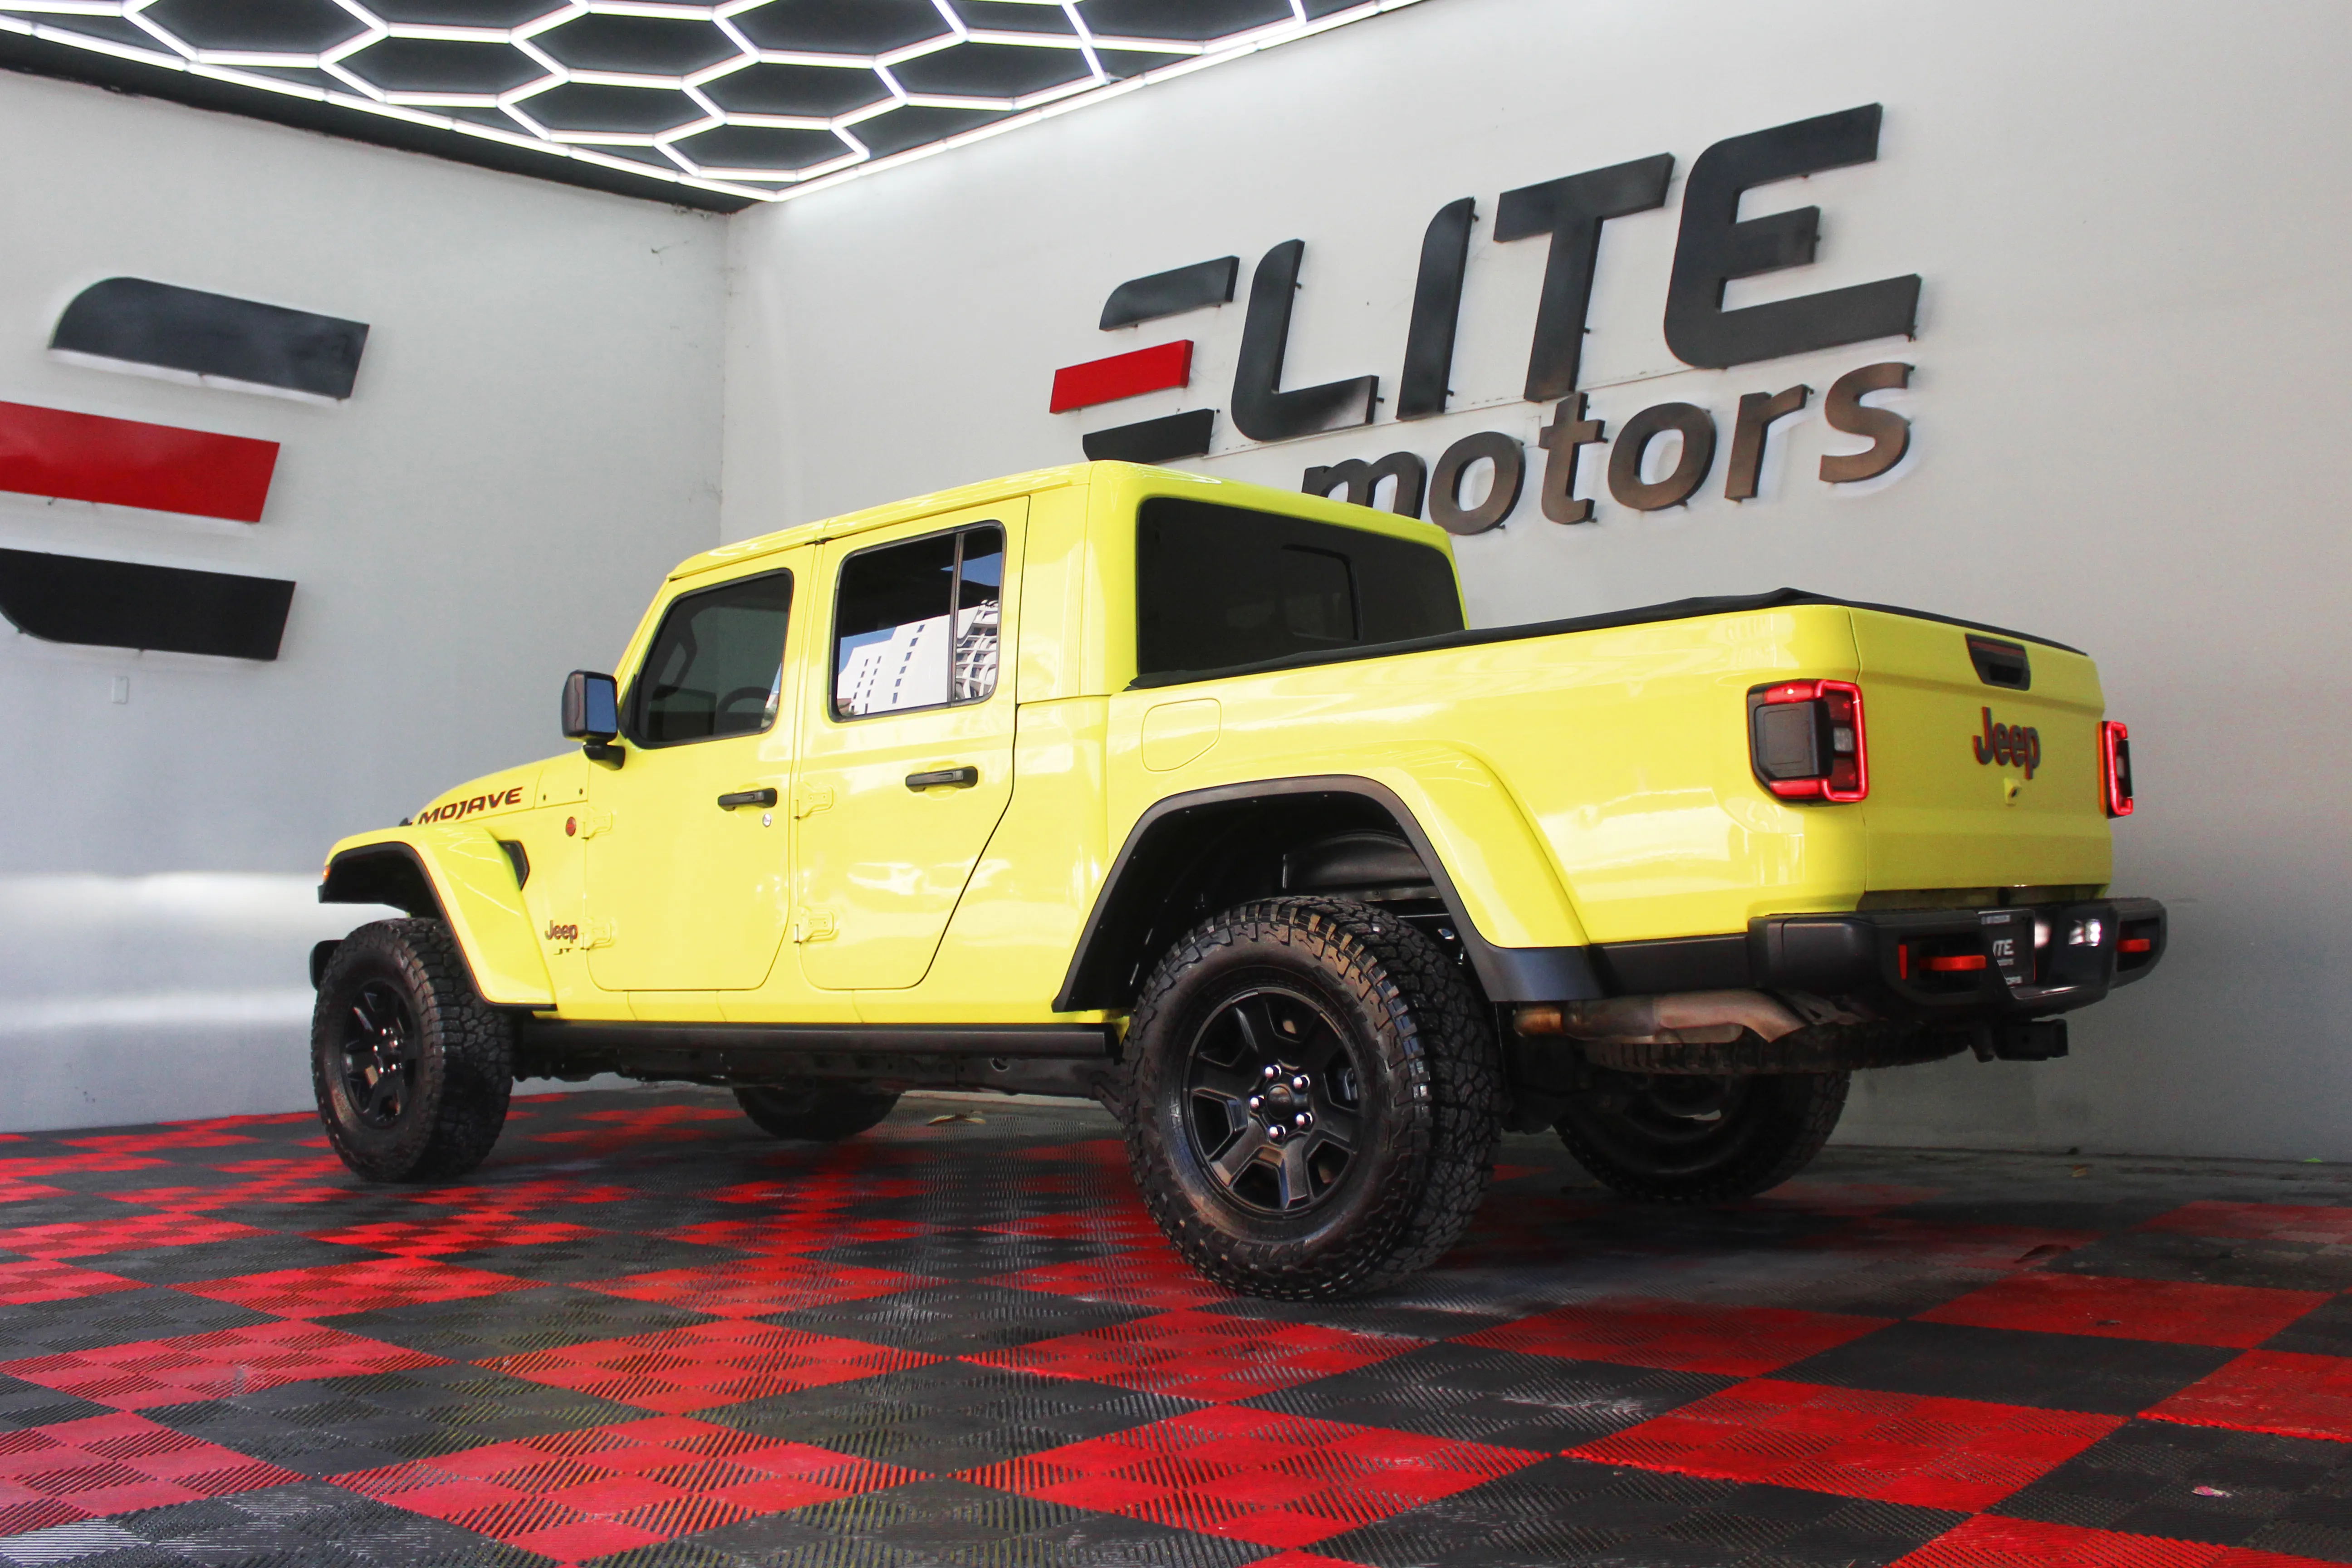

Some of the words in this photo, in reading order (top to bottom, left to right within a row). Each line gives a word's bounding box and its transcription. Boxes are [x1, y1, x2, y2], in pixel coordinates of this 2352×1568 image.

[1050, 103, 1922, 465] ELITE
[1301, 363, 1911, 535] motors
[1972, 706, 2041, 780] Jeep
[418, 786, 523, 824] MOJAVE
[544, 920, 578, 944] Jeep
